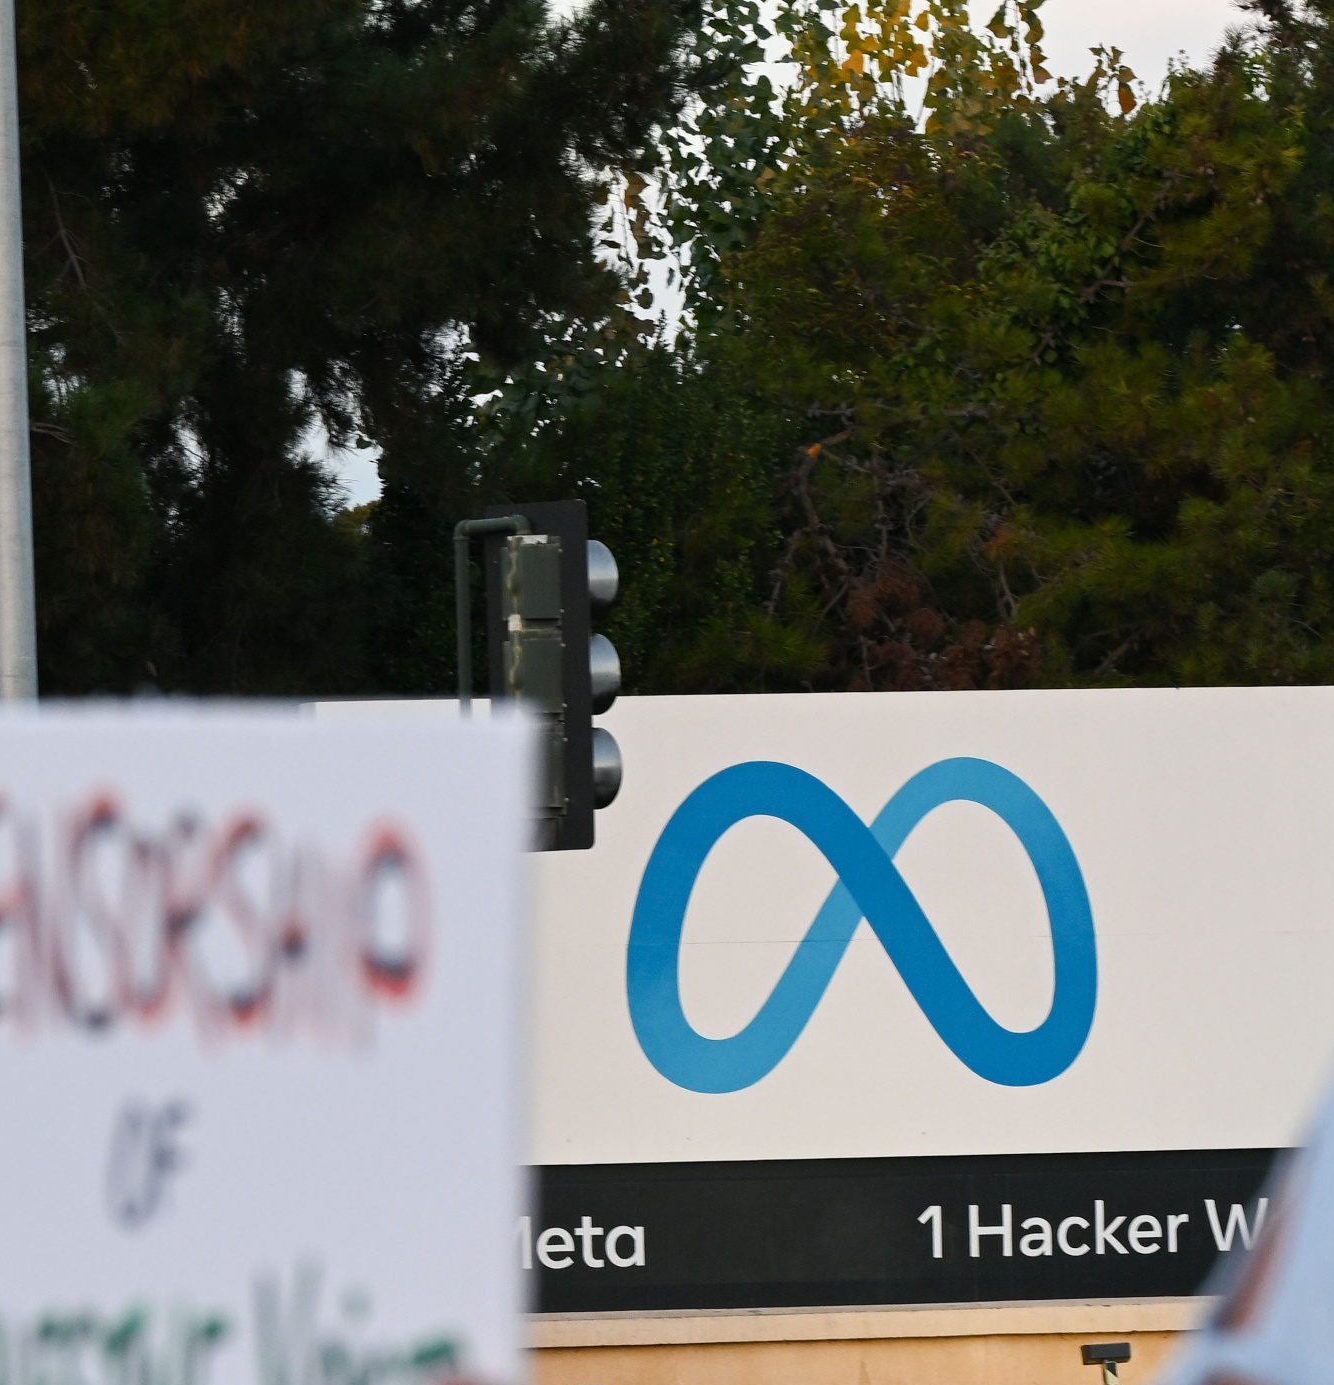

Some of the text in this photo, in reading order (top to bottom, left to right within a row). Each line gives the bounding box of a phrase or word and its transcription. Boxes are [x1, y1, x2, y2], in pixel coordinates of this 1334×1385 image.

[104, 1094, 197, 1236] OF
[517, 1215, 646, 1270] eta
[917, 1205, 943, 1259] 1
[968, 1199, 1190, 1258] Hacker
